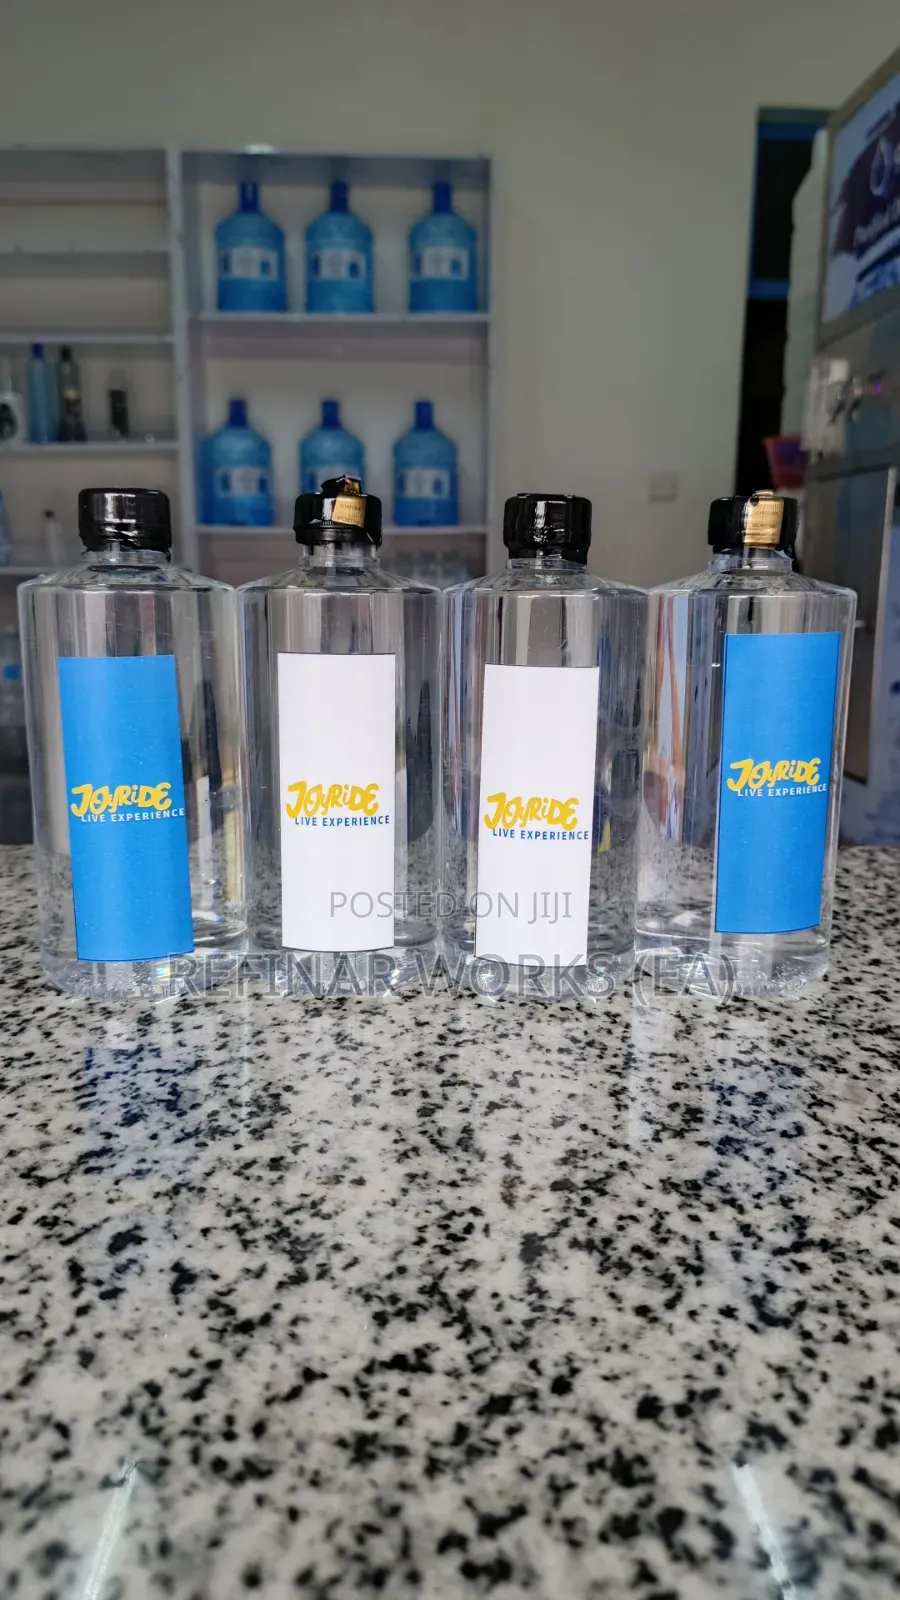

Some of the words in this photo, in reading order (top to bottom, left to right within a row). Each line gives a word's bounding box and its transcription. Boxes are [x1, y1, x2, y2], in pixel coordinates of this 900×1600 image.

[737, 787, 763, 798] LIVE
[768, 783, 828, 797] EXPERIENCE
[81, 813, 107, 823] LIVE
[110, 807, 186, 823] EXPERIENCE
[295, 816, 318, 827] LIVE
[322, 815, 391, 827] EXPERIENCE
[492, 827, 515, 839] LIVE
[520, 828, 589, 841] EXPERIENCE
